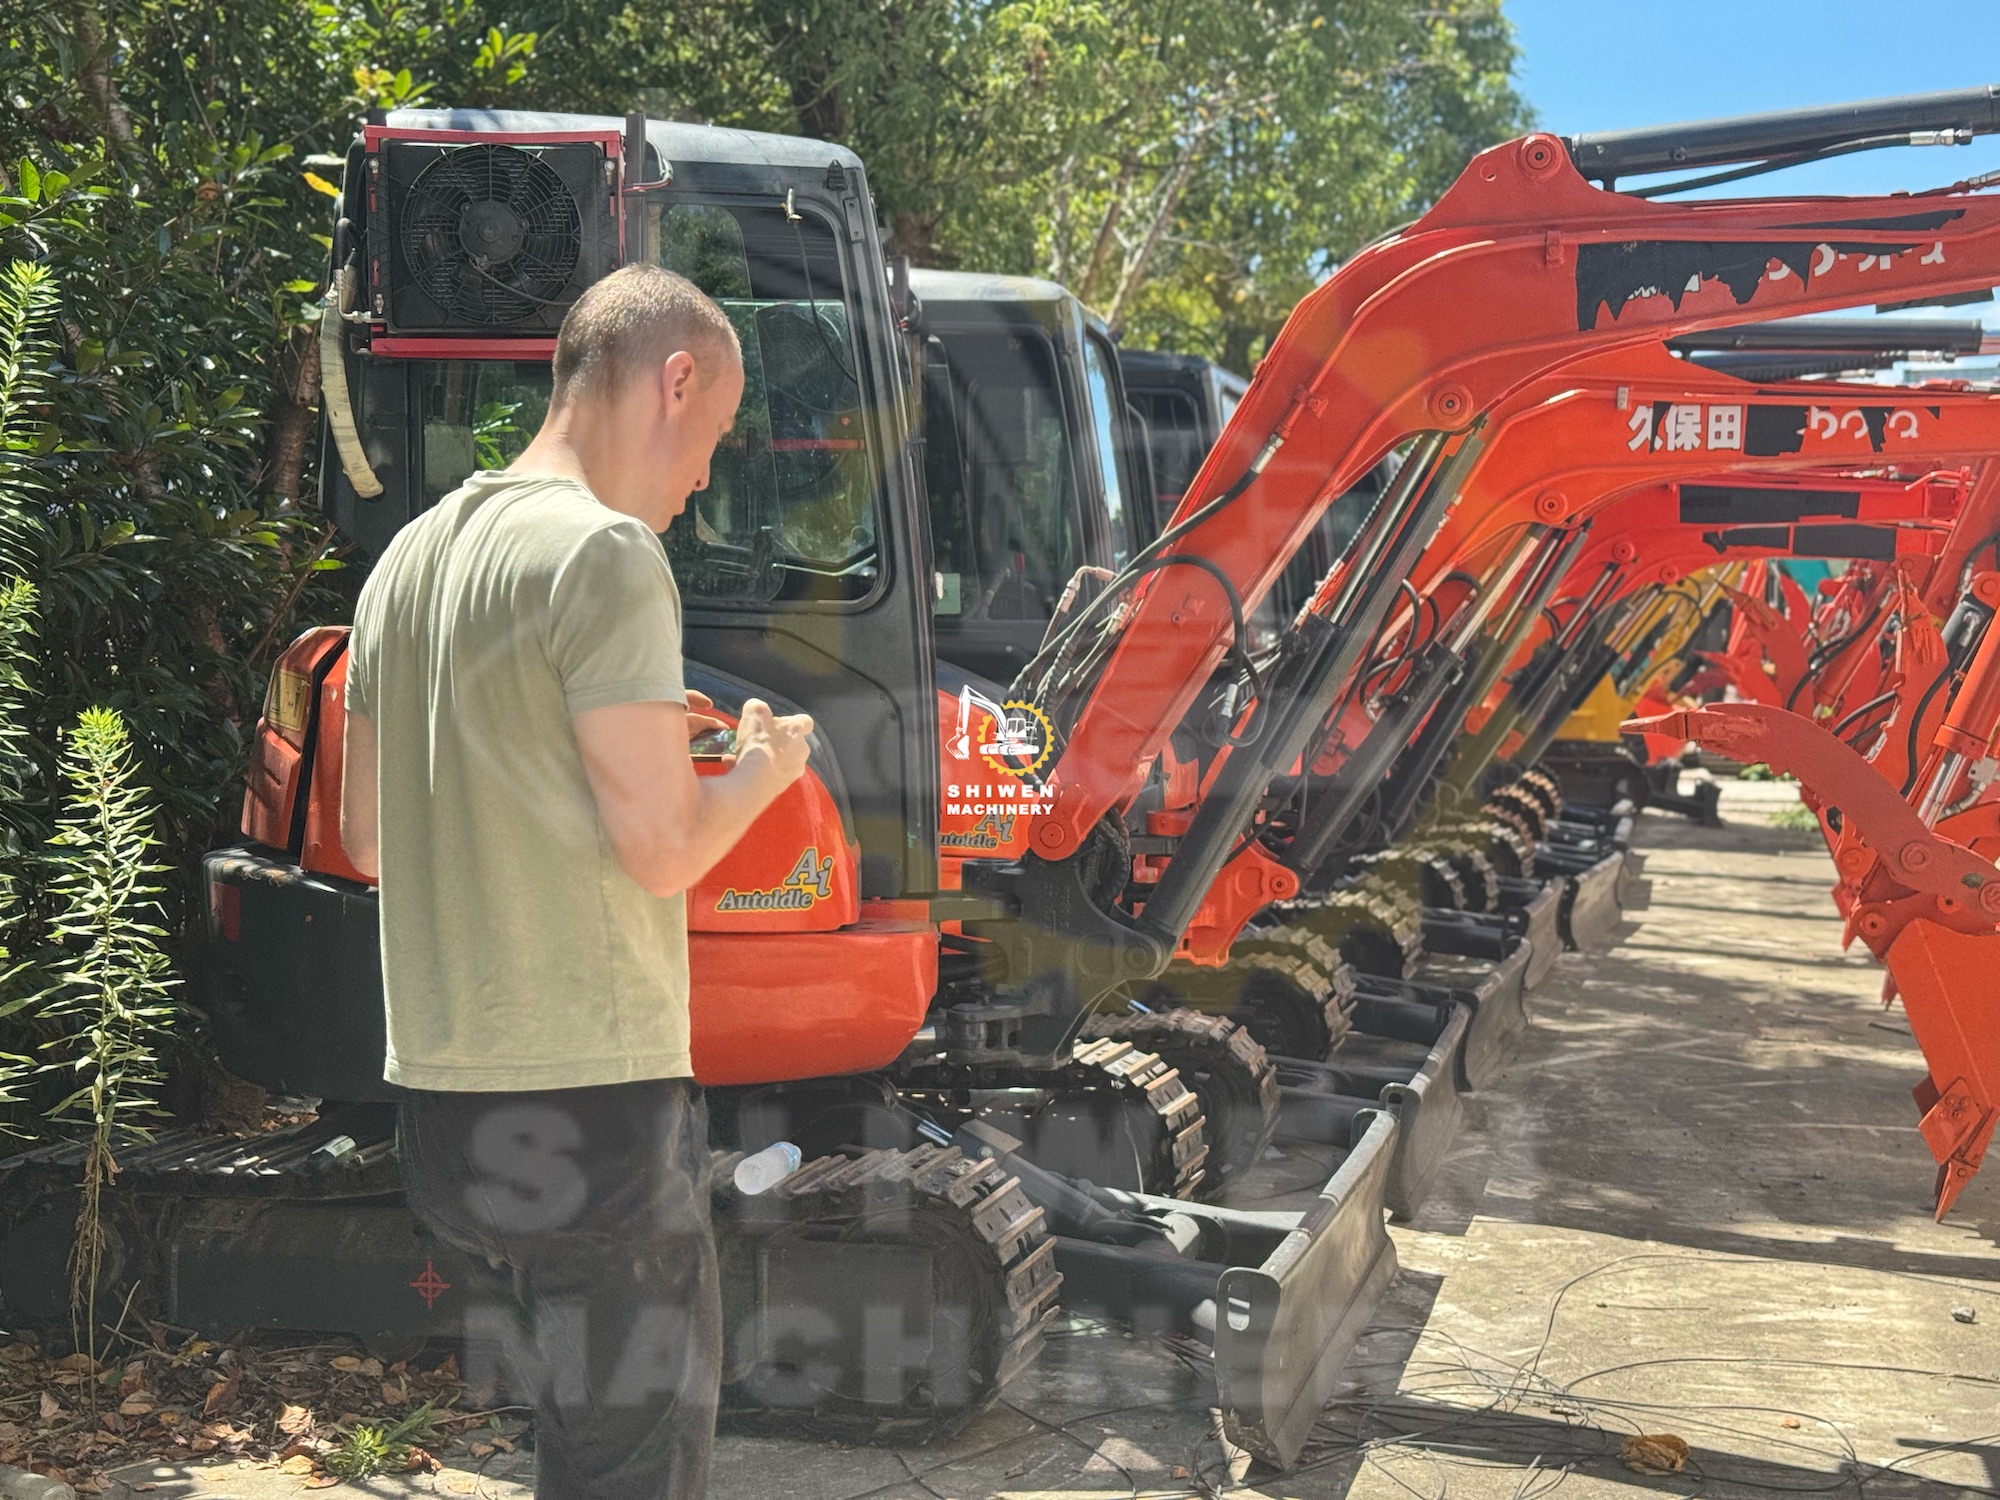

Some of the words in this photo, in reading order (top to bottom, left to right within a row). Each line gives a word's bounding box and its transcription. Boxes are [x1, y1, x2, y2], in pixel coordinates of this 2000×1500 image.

[1627, 404, 1743, 452] 久保田
[784, 848, 833, 898] Ai
